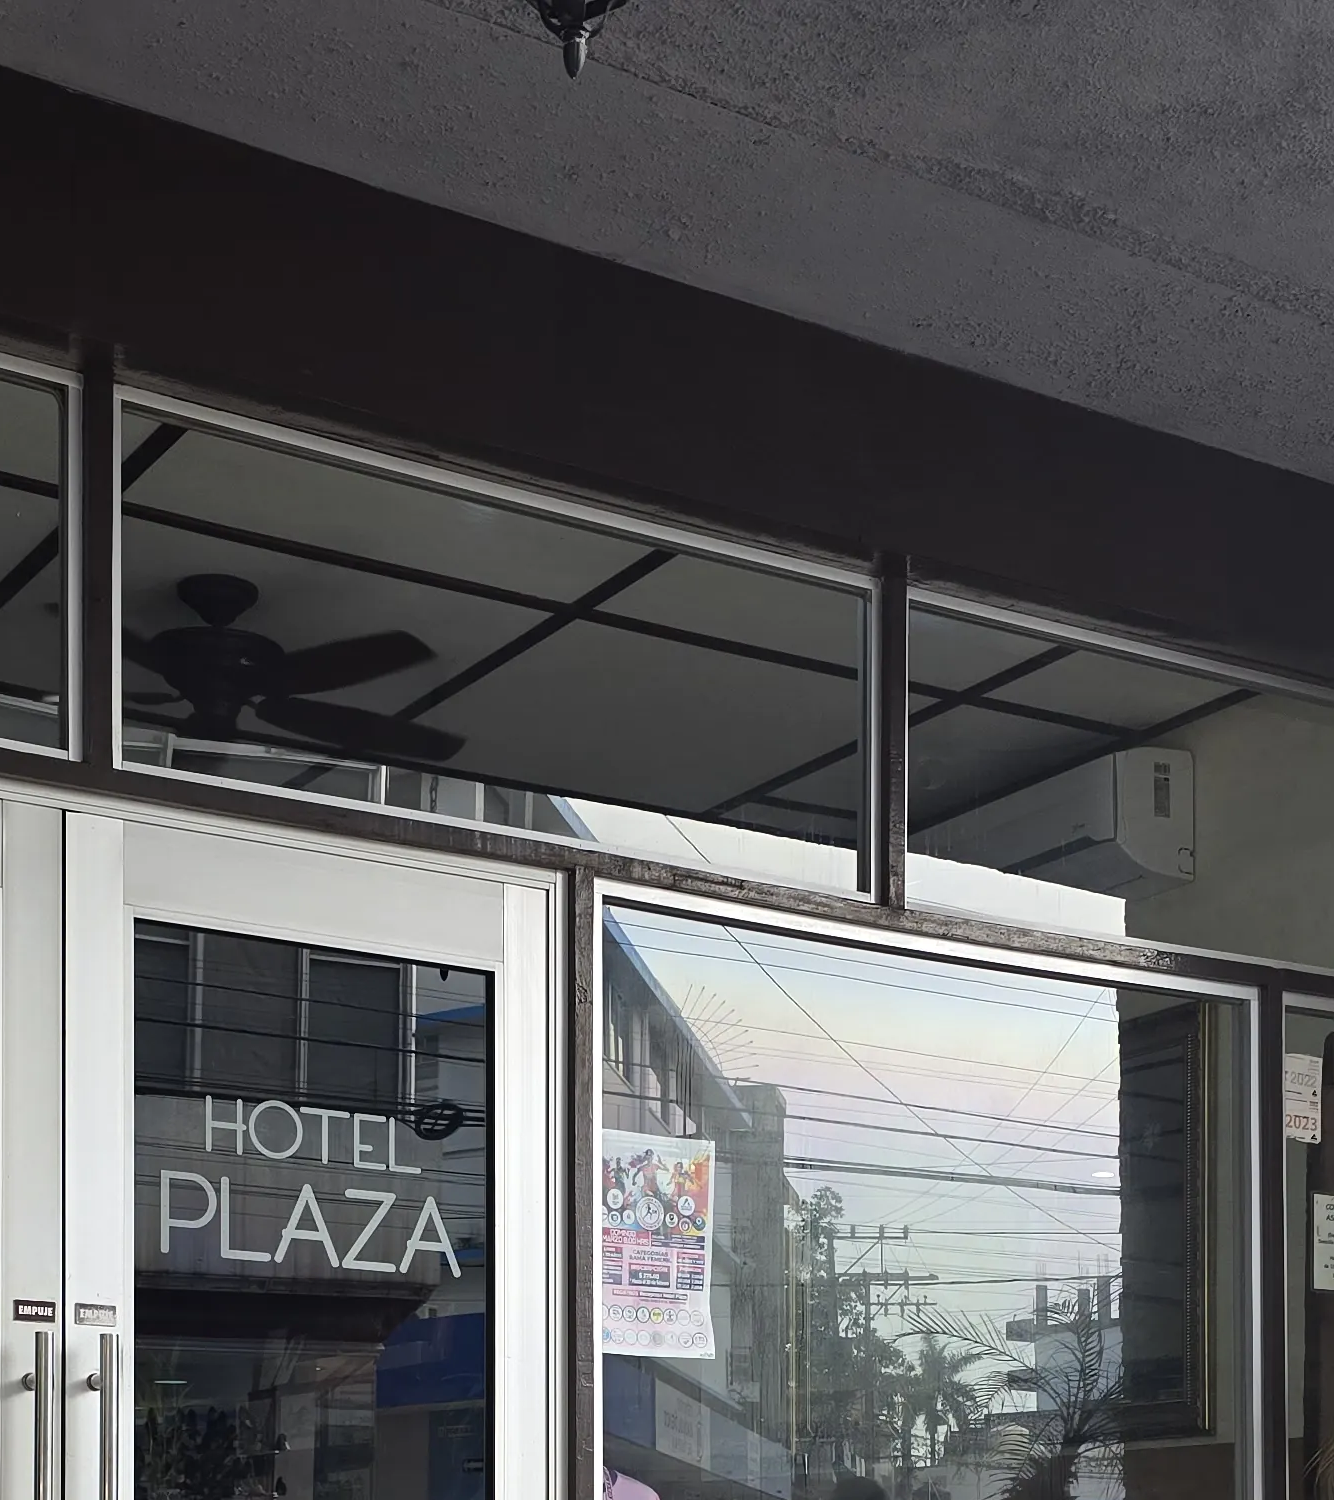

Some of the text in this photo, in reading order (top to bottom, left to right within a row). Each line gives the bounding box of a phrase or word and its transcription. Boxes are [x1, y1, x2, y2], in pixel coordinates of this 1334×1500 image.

[1290, 1071, 1317, 1088] 2022
[1285, 1114, 1318, 1131] 2023
[205, 1095, 422, 1174] HOTEL
[160, 1169, 462, 1279] PLAZA
[18, 1305, 53, 1316] EMPUJE
